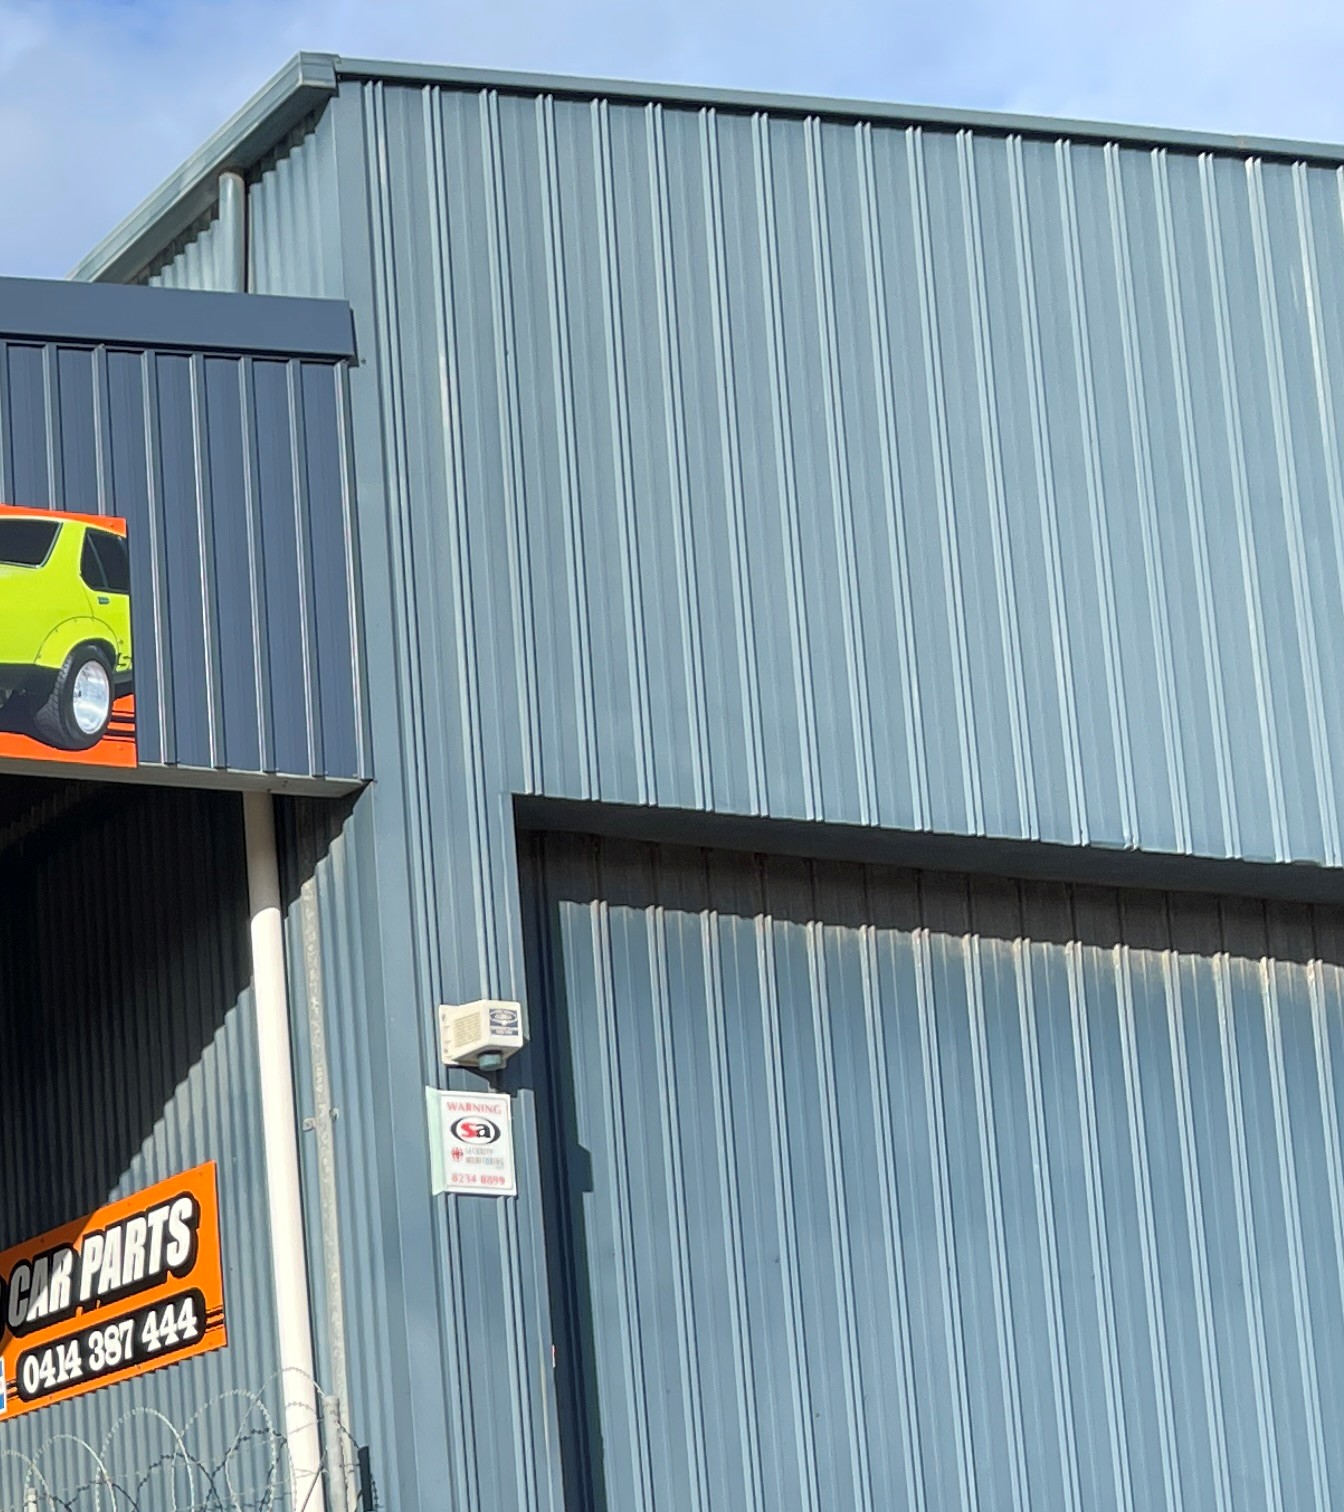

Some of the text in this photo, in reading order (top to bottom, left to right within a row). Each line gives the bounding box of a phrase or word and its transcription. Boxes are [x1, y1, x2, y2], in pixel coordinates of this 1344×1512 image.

[447, 1101, 502, 1115] WARNING
[9, 1248, 74, 1328] CAR
[79, 1196, 193, 1301] PARTS
[22, 1296, 199, 1395] 0414 387 444
